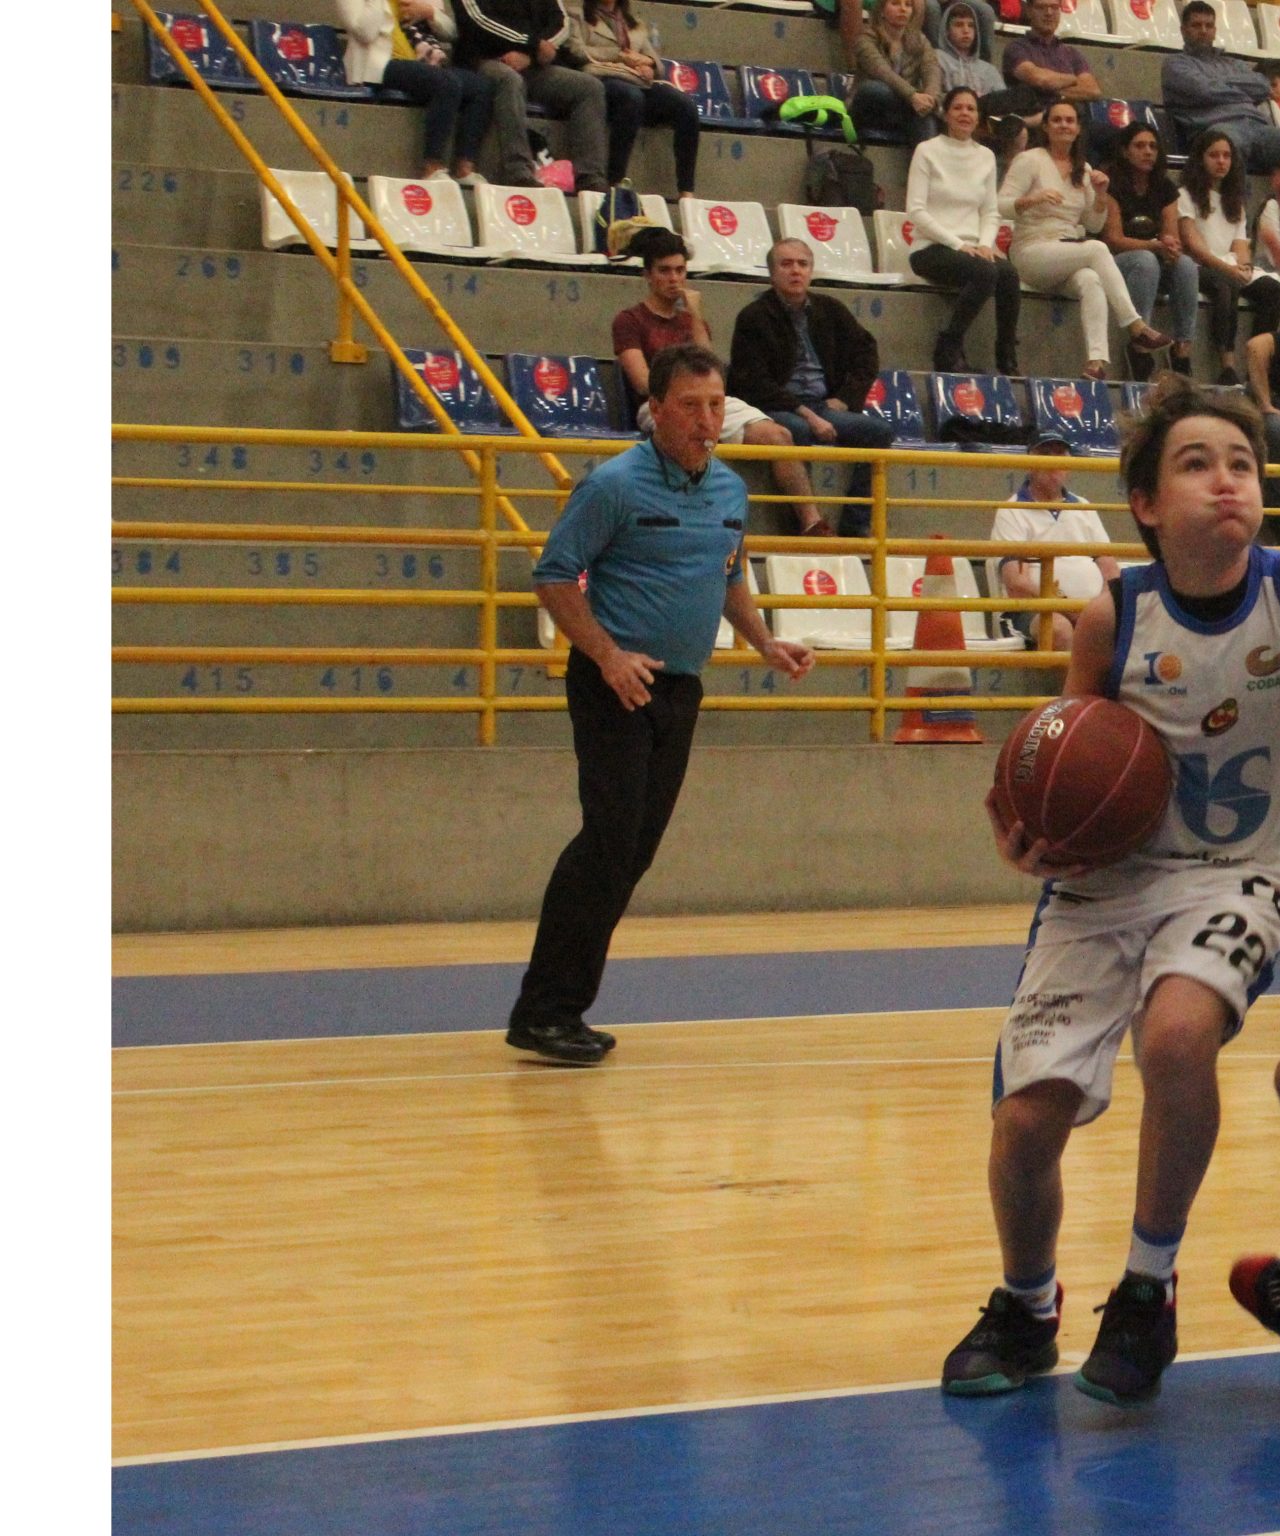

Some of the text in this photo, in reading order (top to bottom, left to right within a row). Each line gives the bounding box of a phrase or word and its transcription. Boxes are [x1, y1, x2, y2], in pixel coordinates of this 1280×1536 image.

[316, 108, 349, 129] 14
[715, 139, 743, 161] 10
[118, 169, 178, 194] 226
[176, 254, 242, 280] 269
[443, 271, 479, 296] 14
[545, 278, 581, 303] 13
[855, 296, 883, 319] 10
[238, 349, 305, 376] 310
[177, 445, 248, 471] 348
[308, 449, 377, 476] 349
[907, 468, 939, 491] 11
[247, 550, 321, 577] 385
[375, 553, 445, 579] 386
[180, 666, 255, 693] 415
[319, 666, 394, 693] 416
[738, 669, 776, 695] 14
